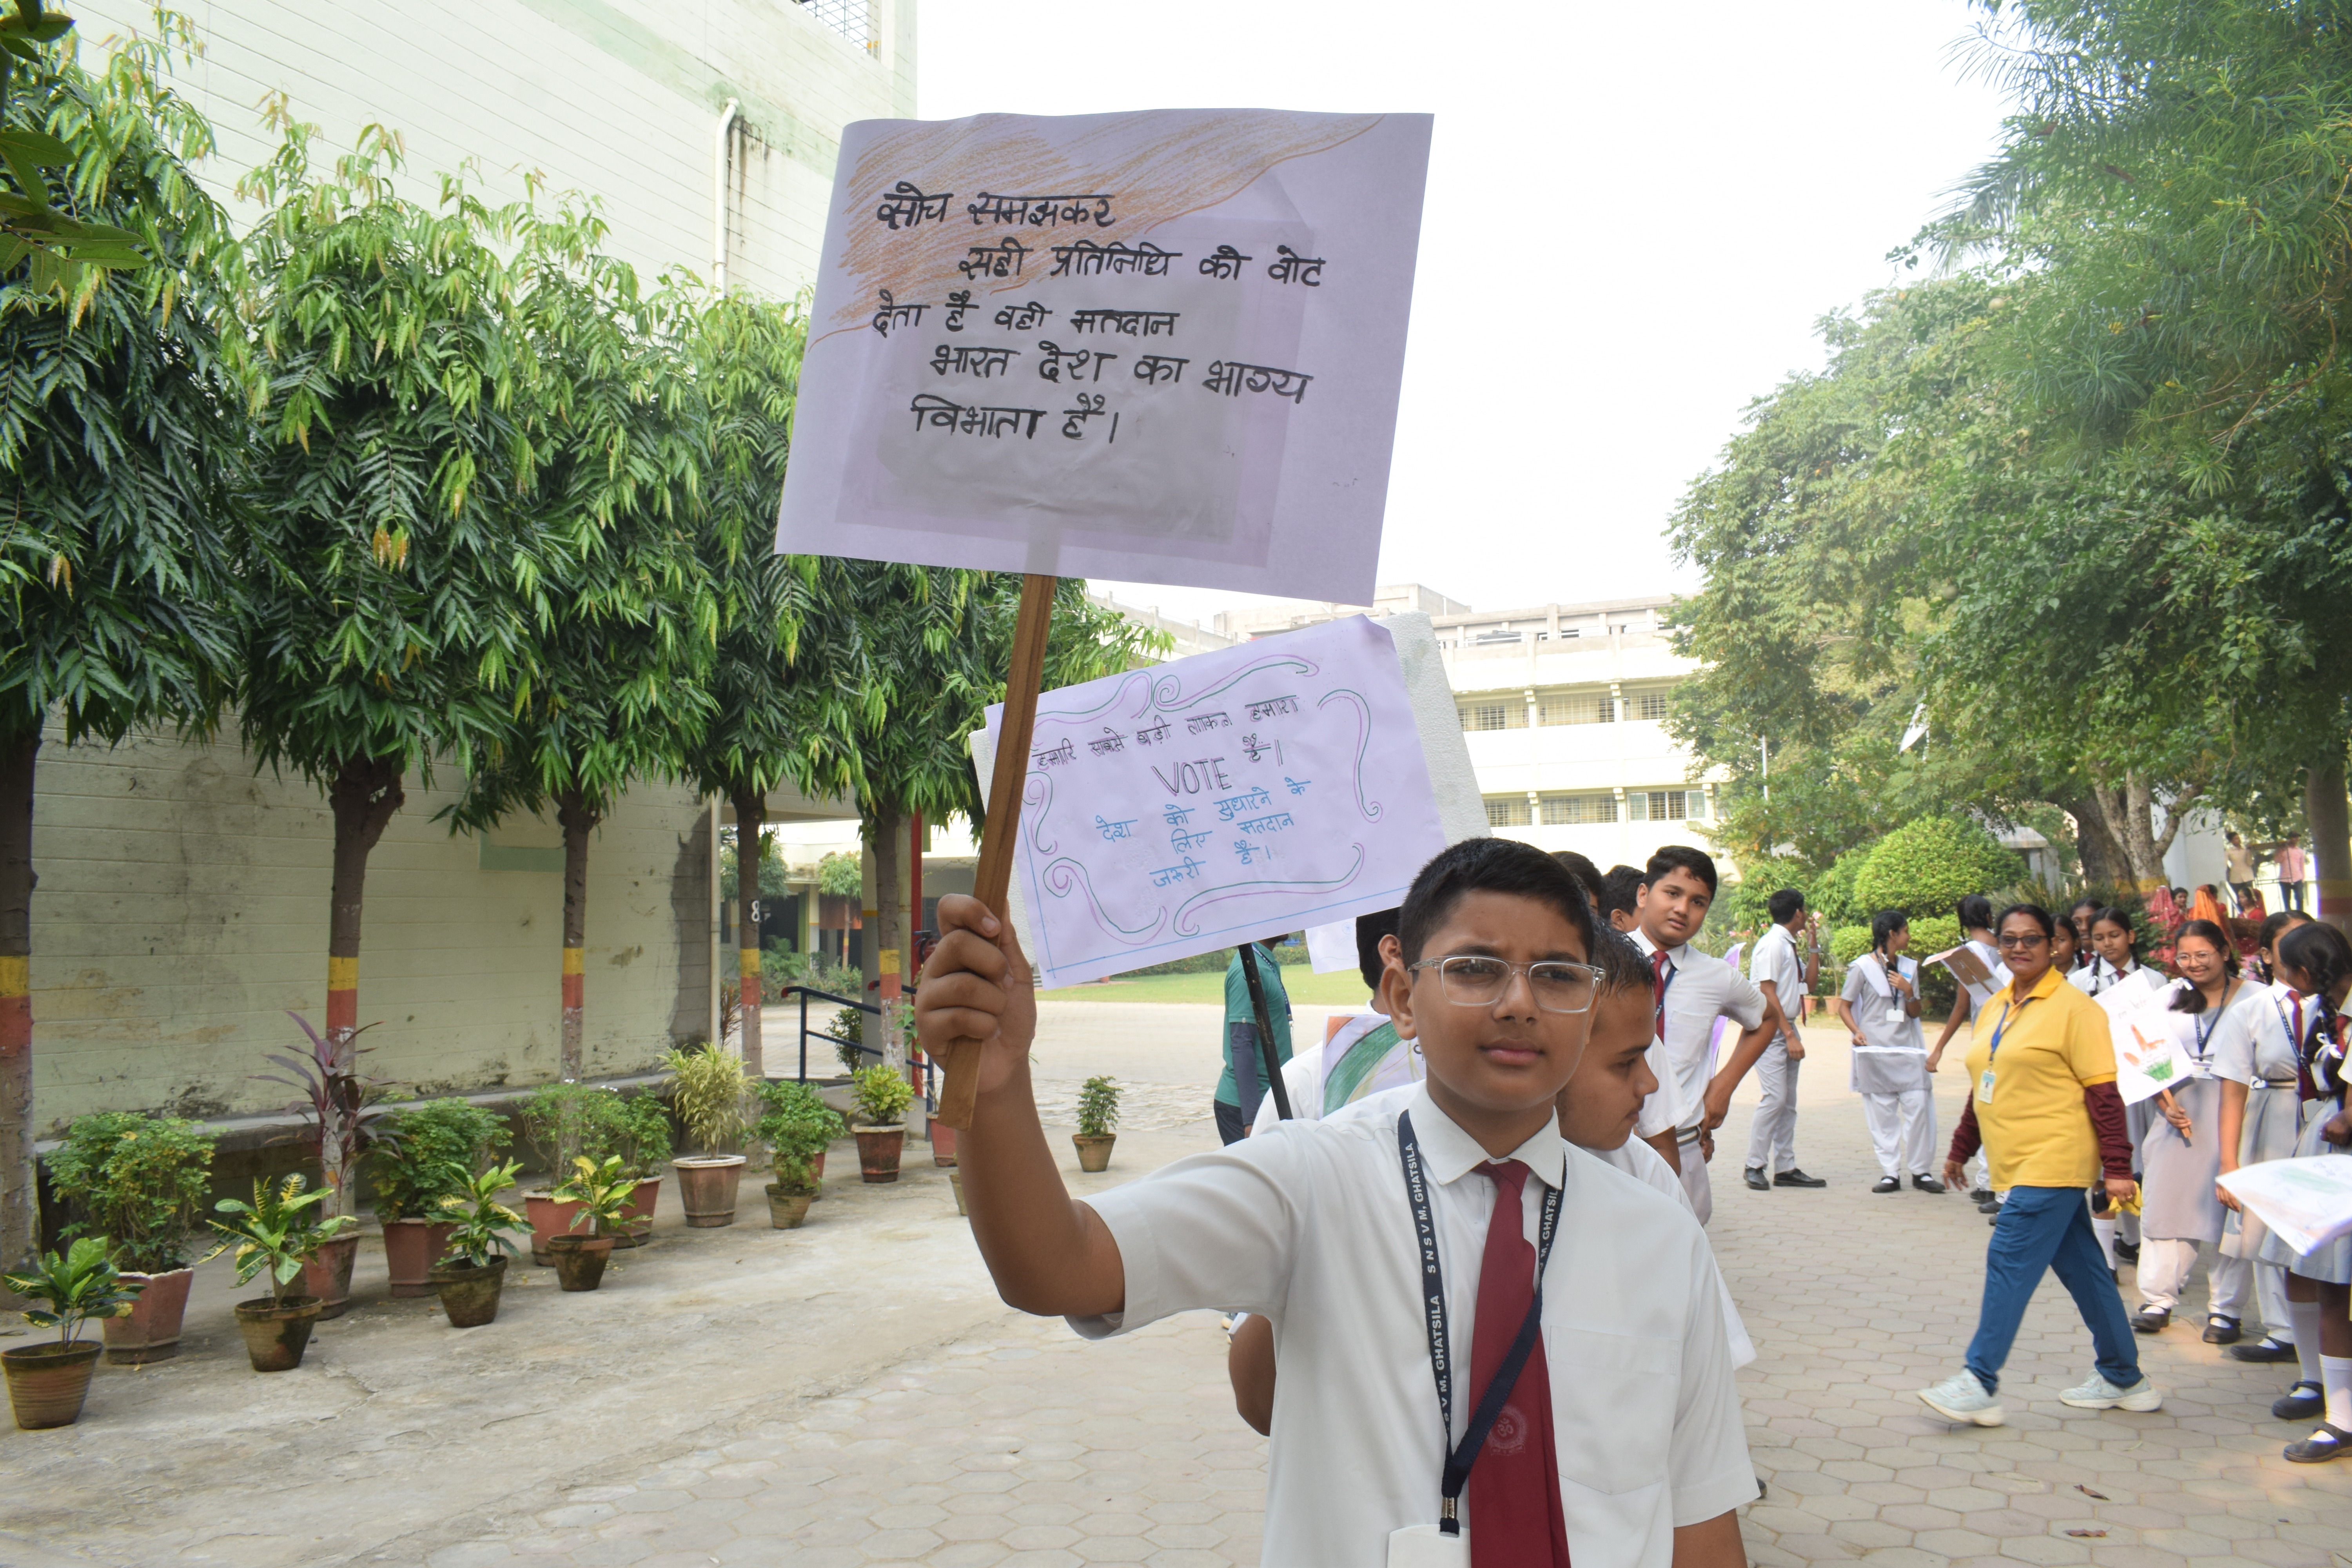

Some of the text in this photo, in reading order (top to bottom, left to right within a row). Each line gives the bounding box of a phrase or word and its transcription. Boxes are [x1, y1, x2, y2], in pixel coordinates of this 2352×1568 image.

[877, 181, 1115, 230] सोच समझकर
[958, 236, 1326, 287] सही प्रतिनिधि को वोट
[873, 289, 931, 338] देता
[995, 301, 1053, 330] वही
[1070, 310, 1180, 337] मतदान
[930, 340, 1314, 404] भारत देश का भाग्य
[1244, 695, 1300, 722] हमारा
[1151, 757, 1232, 797] VOTE
[1095, 777, 1311, 842] देश को सुधारने के
[1171, 812, 1294, 855] लिए मतदान
[751, 900, 760, 922] 8
[1405, 1142, 1424, 1202] GHATSILA
[1542, 1189, 1558, 1240] GHATSIL
[1430, 1295, 1445, 1370] GHATSILA
